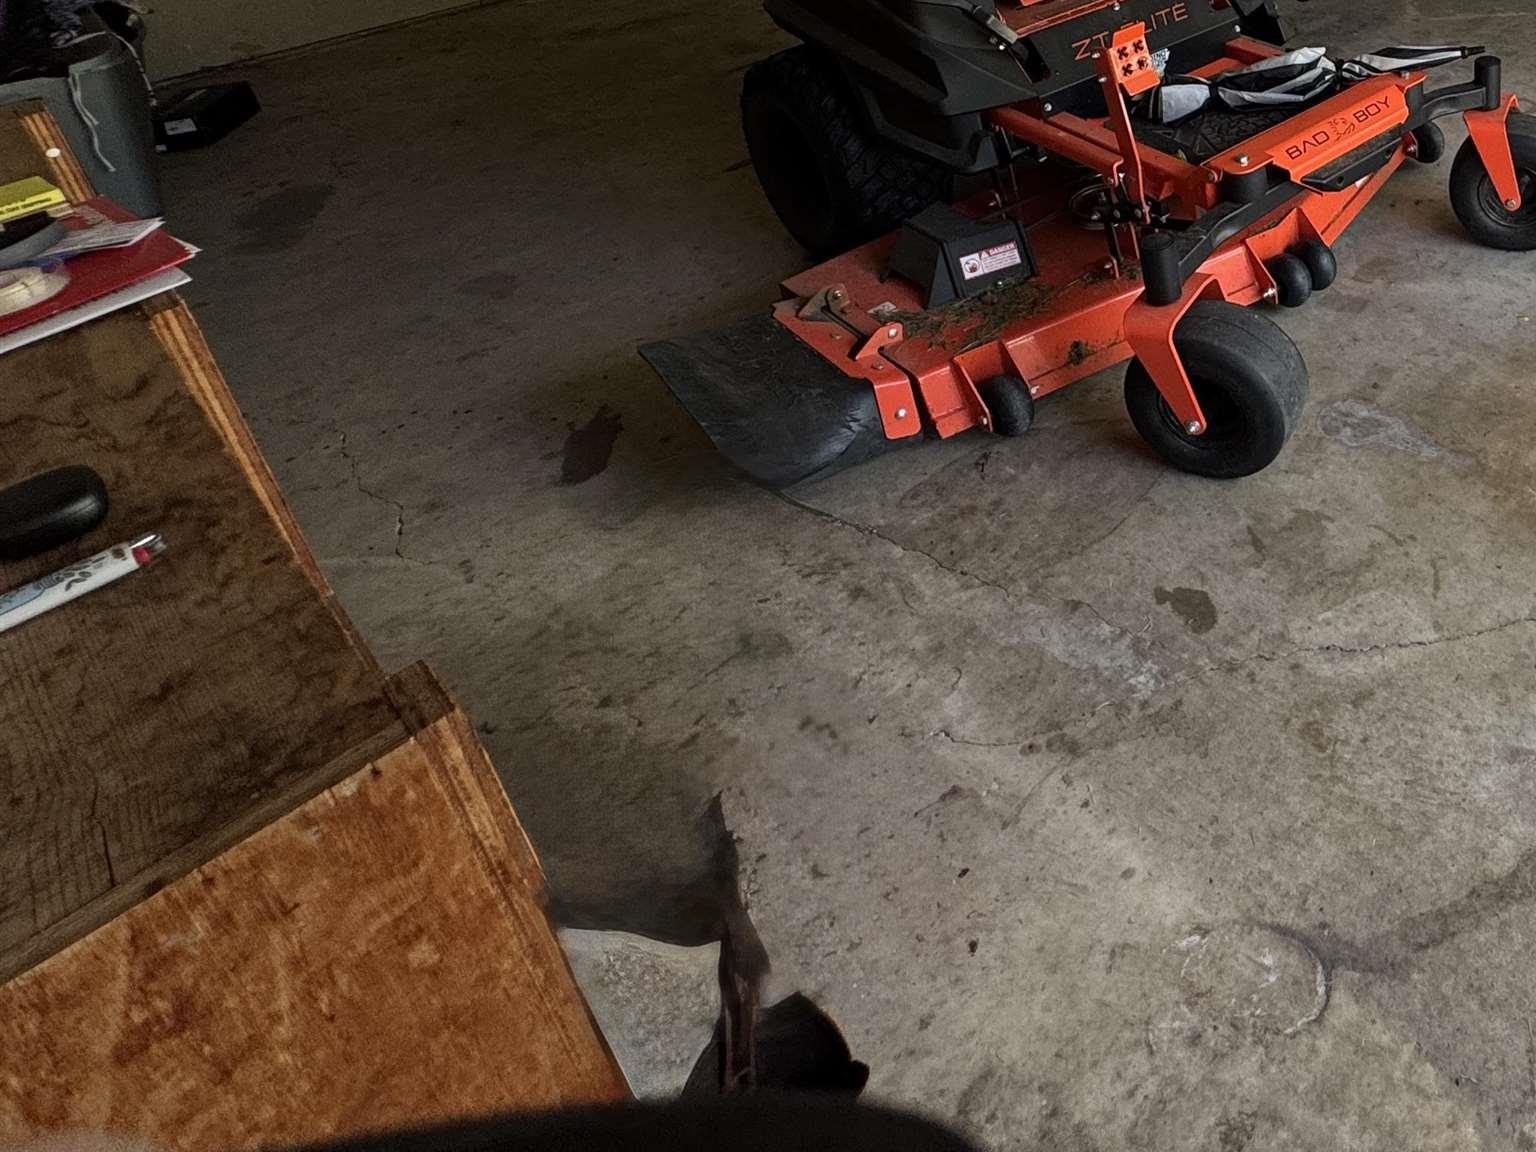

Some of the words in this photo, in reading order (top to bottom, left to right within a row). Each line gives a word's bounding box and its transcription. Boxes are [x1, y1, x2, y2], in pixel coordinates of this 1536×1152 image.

[1072, 31, 1109, 61] ZT
[1285, 130, 1330, 160] BAD
[1353, 90, 1390, 123] BOY
